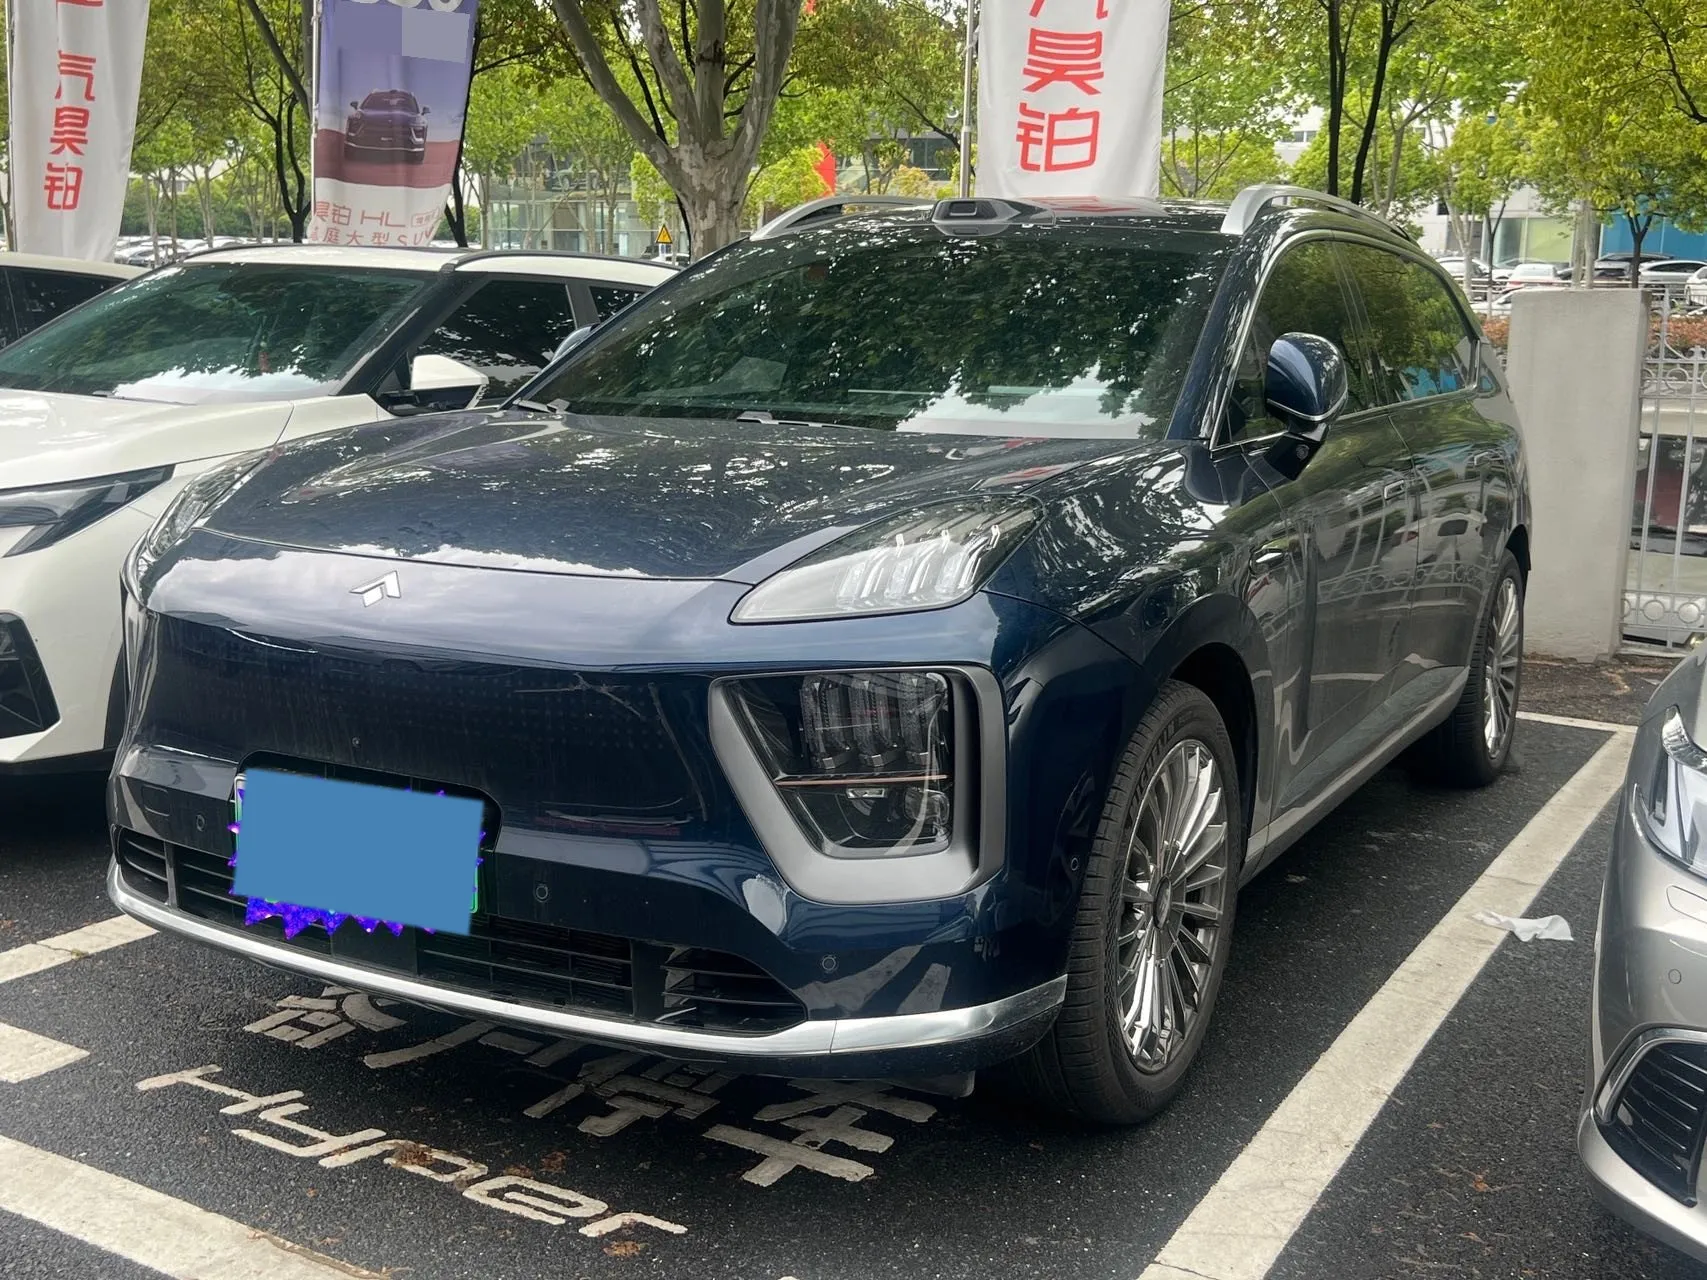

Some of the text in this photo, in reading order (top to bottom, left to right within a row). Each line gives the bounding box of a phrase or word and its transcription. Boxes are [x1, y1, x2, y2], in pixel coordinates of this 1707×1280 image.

[1016, 0, 1108, 172] 昊铂
[360, 210, 406, 228] HL
[136, 1064, 689, 1237] Hyper
